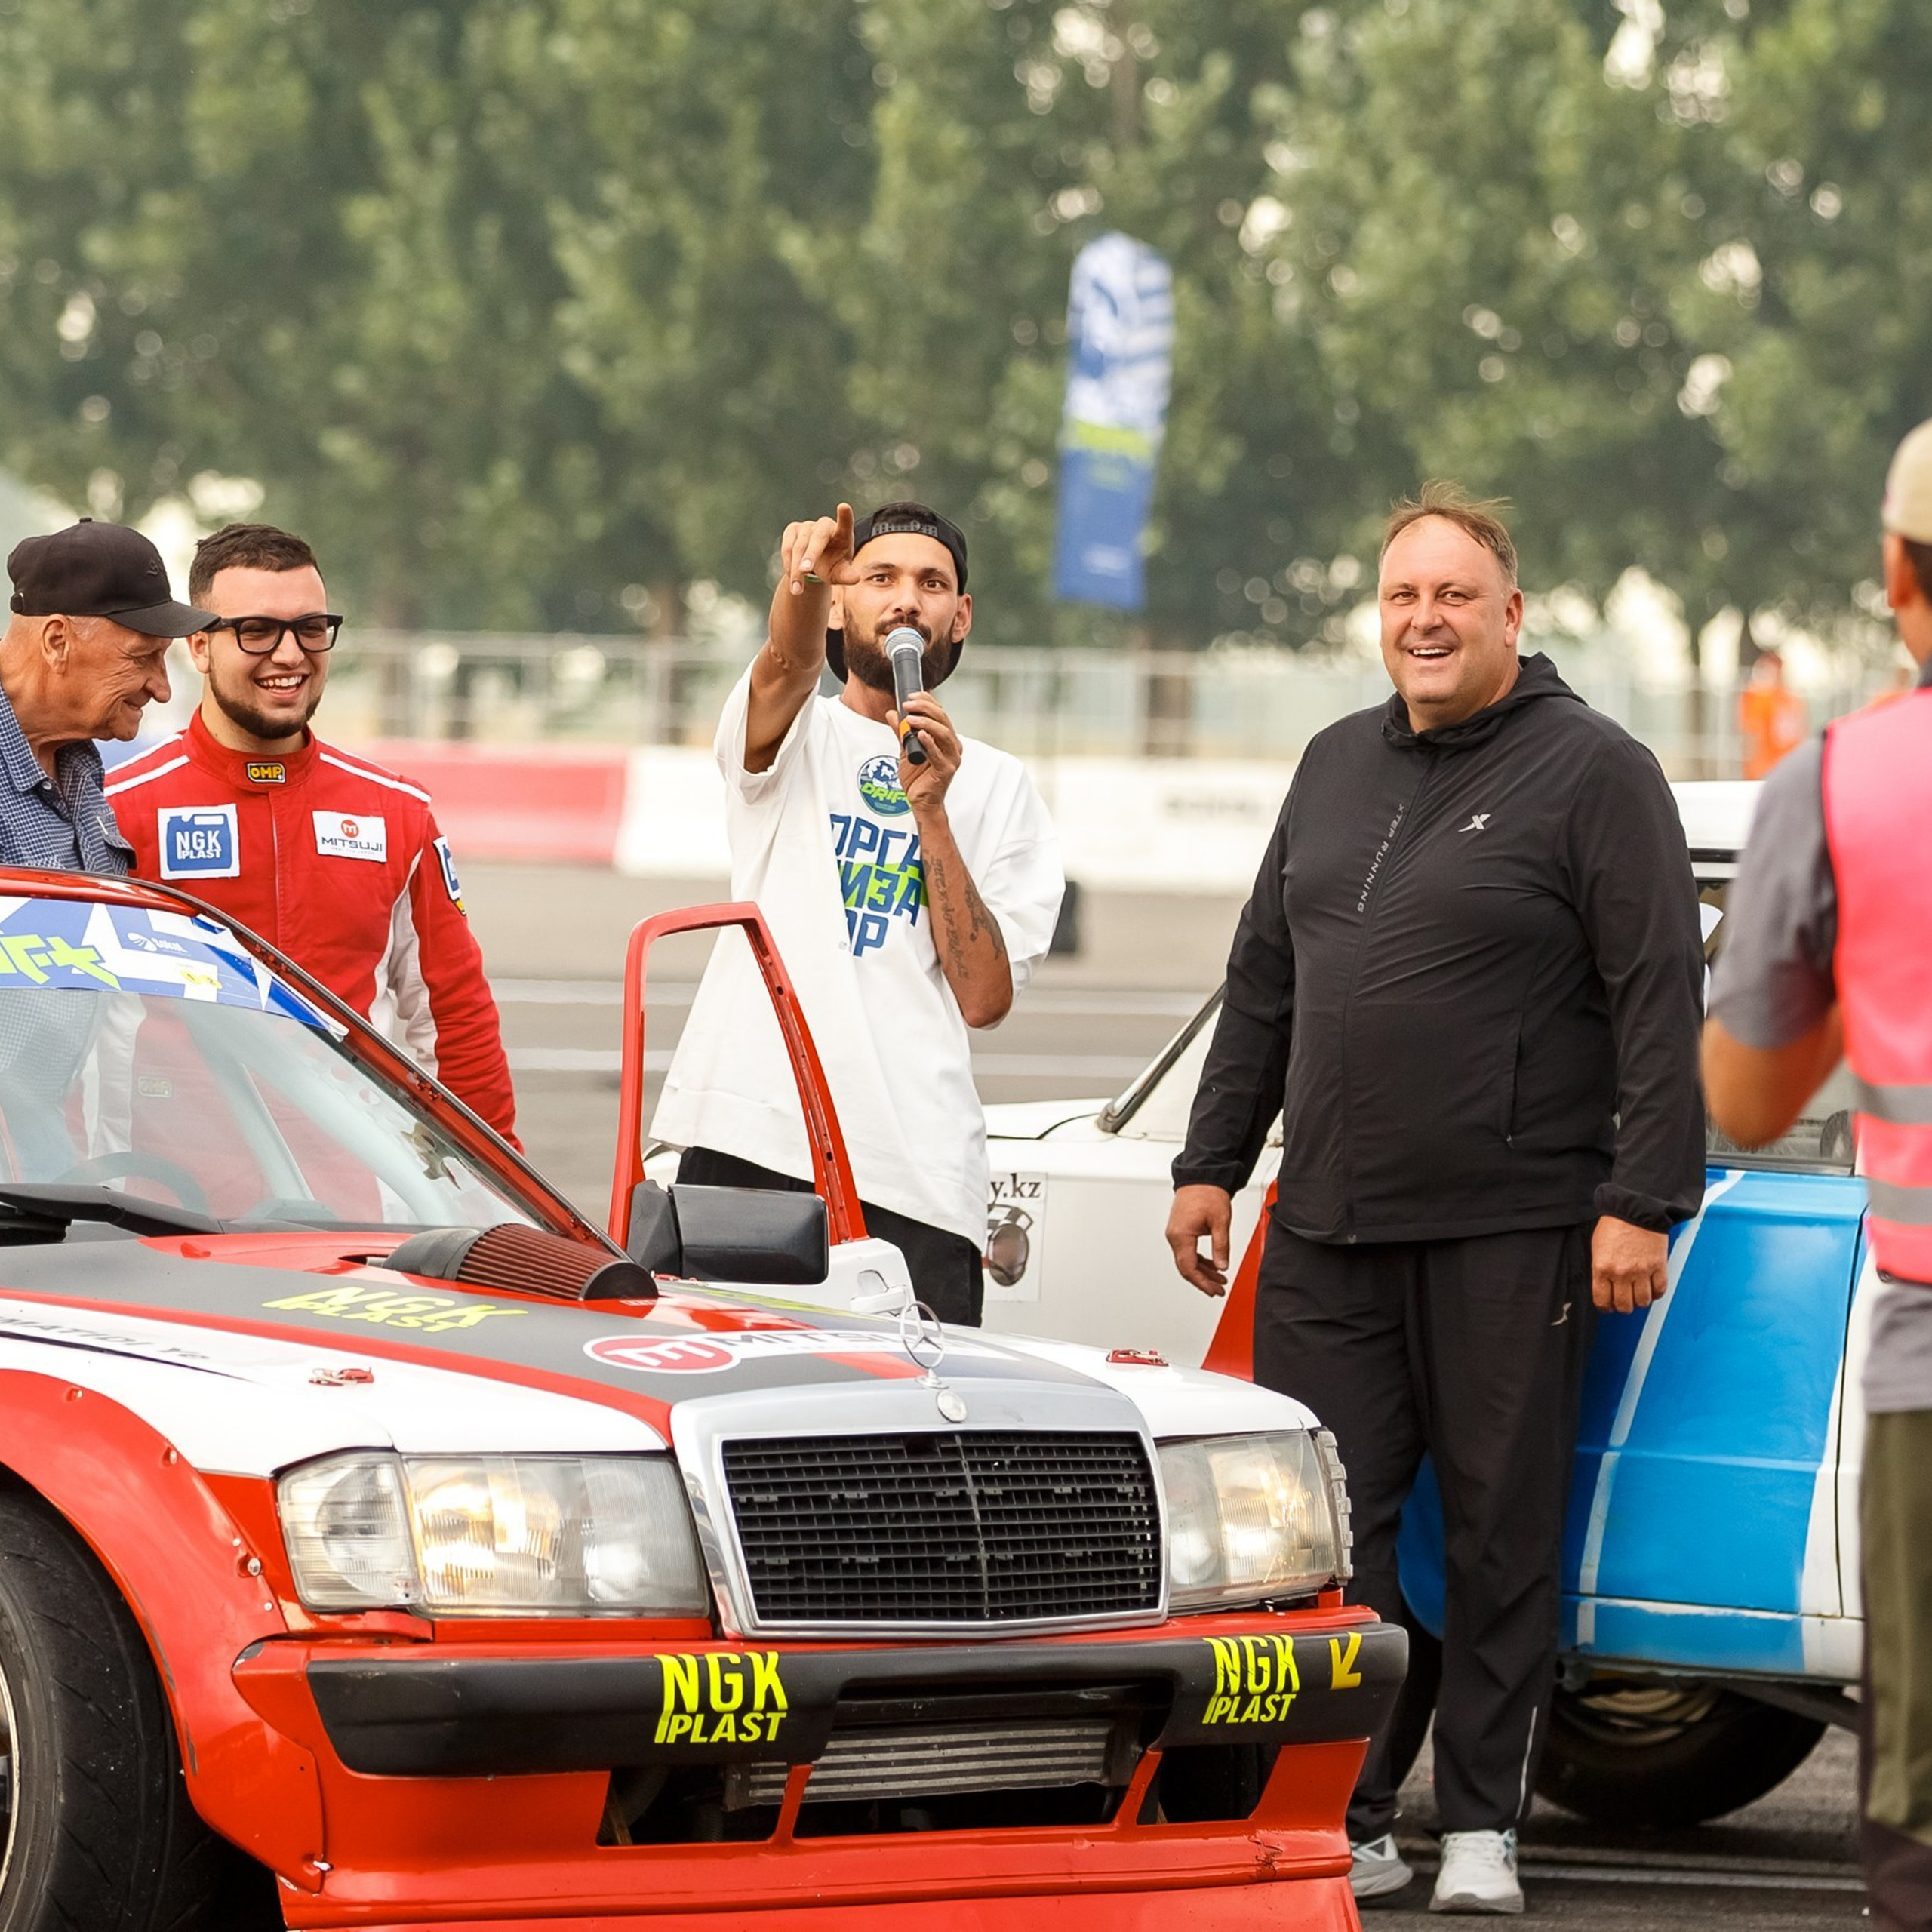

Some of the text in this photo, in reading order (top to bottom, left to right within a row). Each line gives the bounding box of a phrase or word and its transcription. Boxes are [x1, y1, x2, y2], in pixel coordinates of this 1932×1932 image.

[251, 766, 282, 779] OMP
[860, 782, 912, 807] DRIF
[175, 830, 222, 853] NGK
[181, 849, 222, 860] PLAST
[321, 836, 383, 852] MITSUJI
[838, 859, 921, 927] ИЗА
[1357, 841, 1389, 913] RUNNING
[261, 1287, 529, 1326] NGK
[278, 1301, 469, 1333] PLAST
[1202, 1634, 1300, 1696] NGK
[654, 1651, 788, 1713] NGK
[1210, 1693, 1297, 1724] PLAST
[666, 1712, 787, 1744] PLAST
